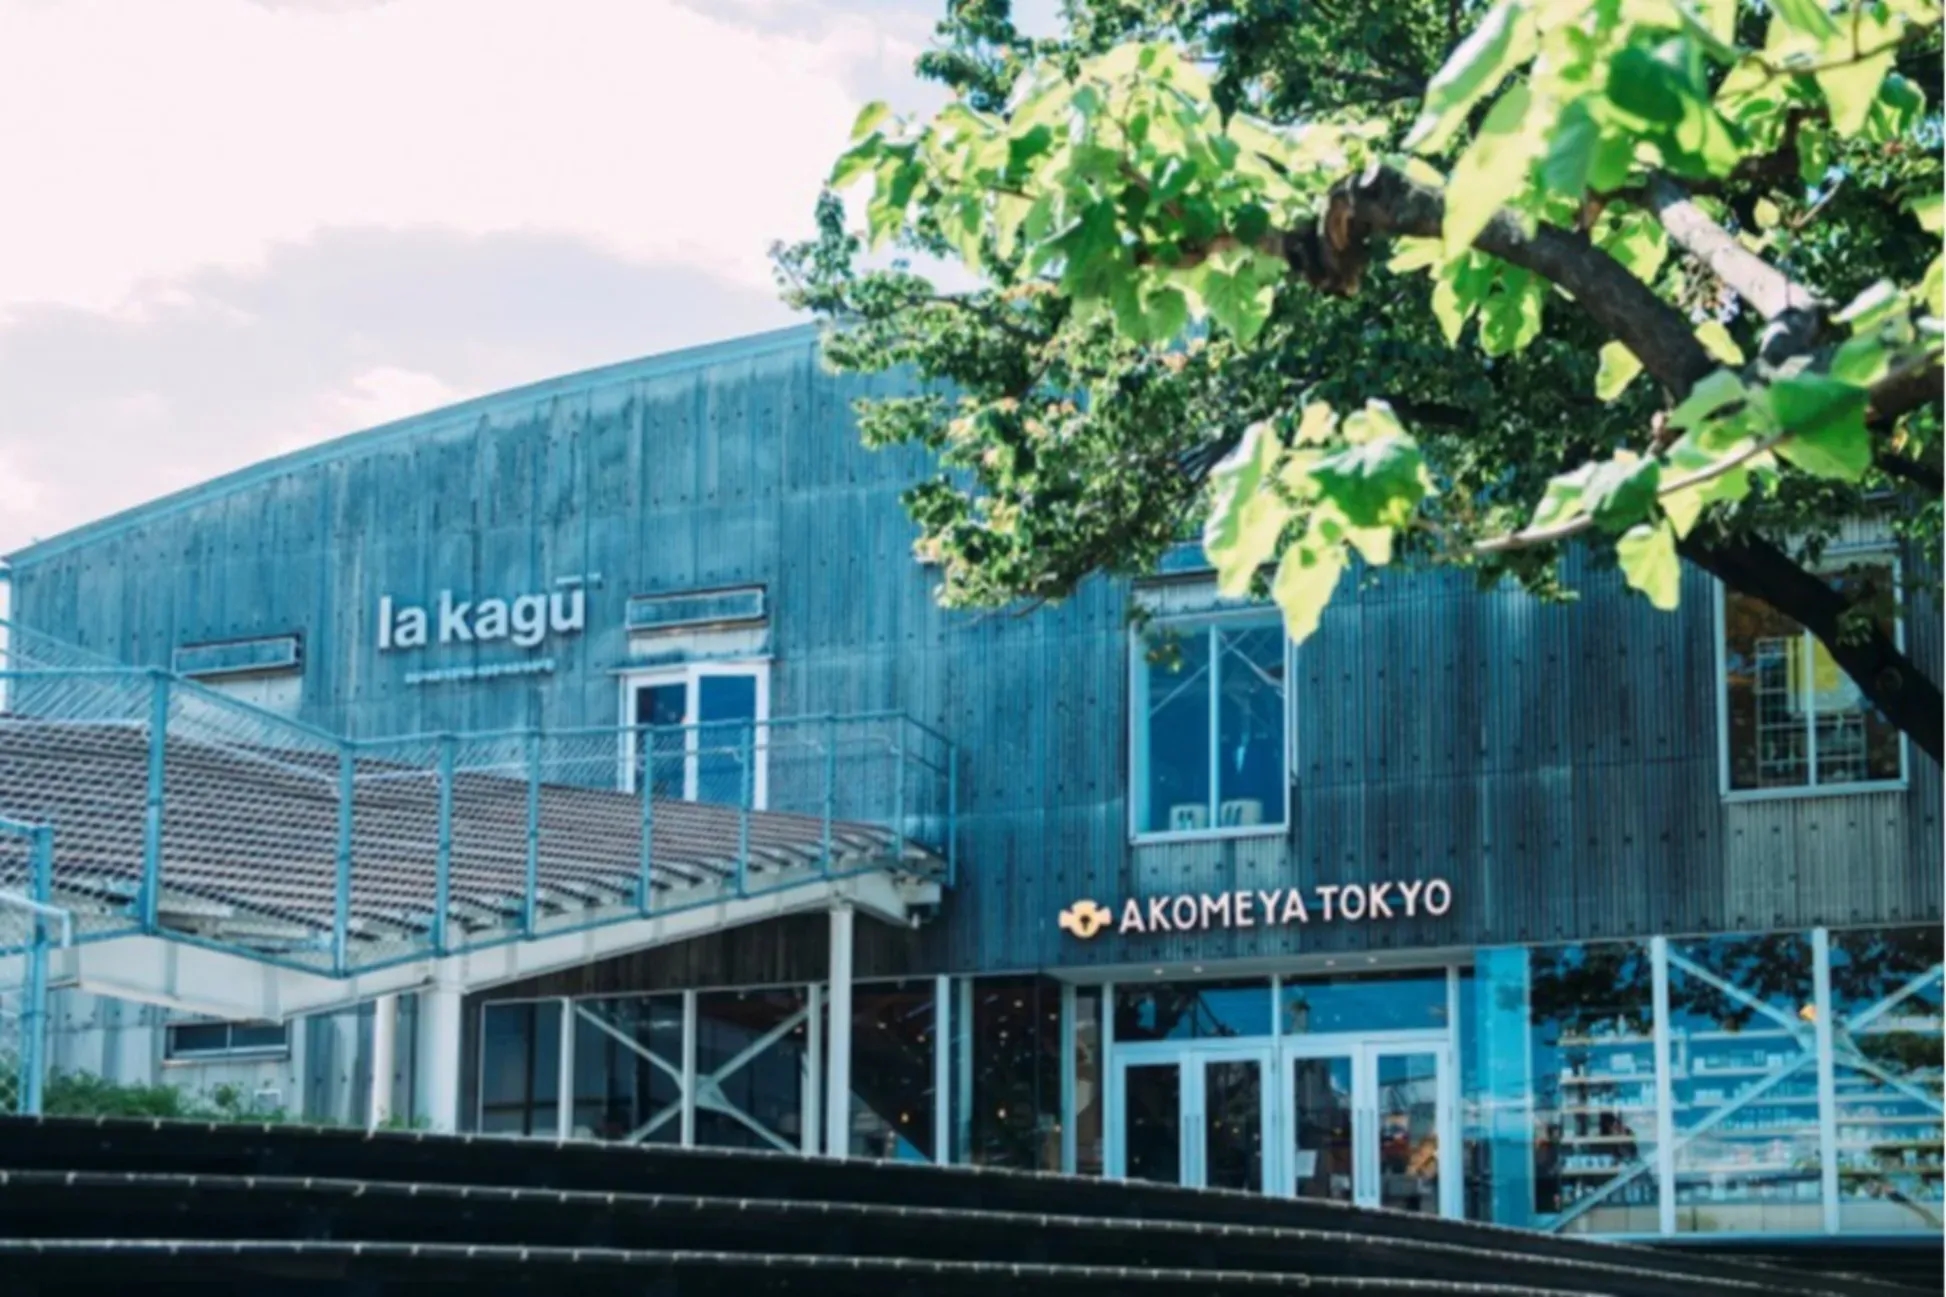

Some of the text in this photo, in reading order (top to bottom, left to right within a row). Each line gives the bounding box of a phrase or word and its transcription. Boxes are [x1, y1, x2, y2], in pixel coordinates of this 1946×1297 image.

[378, 595, 427, 649] la
[1119, 878, 1452, 934] AKOMEYA TOKYO
